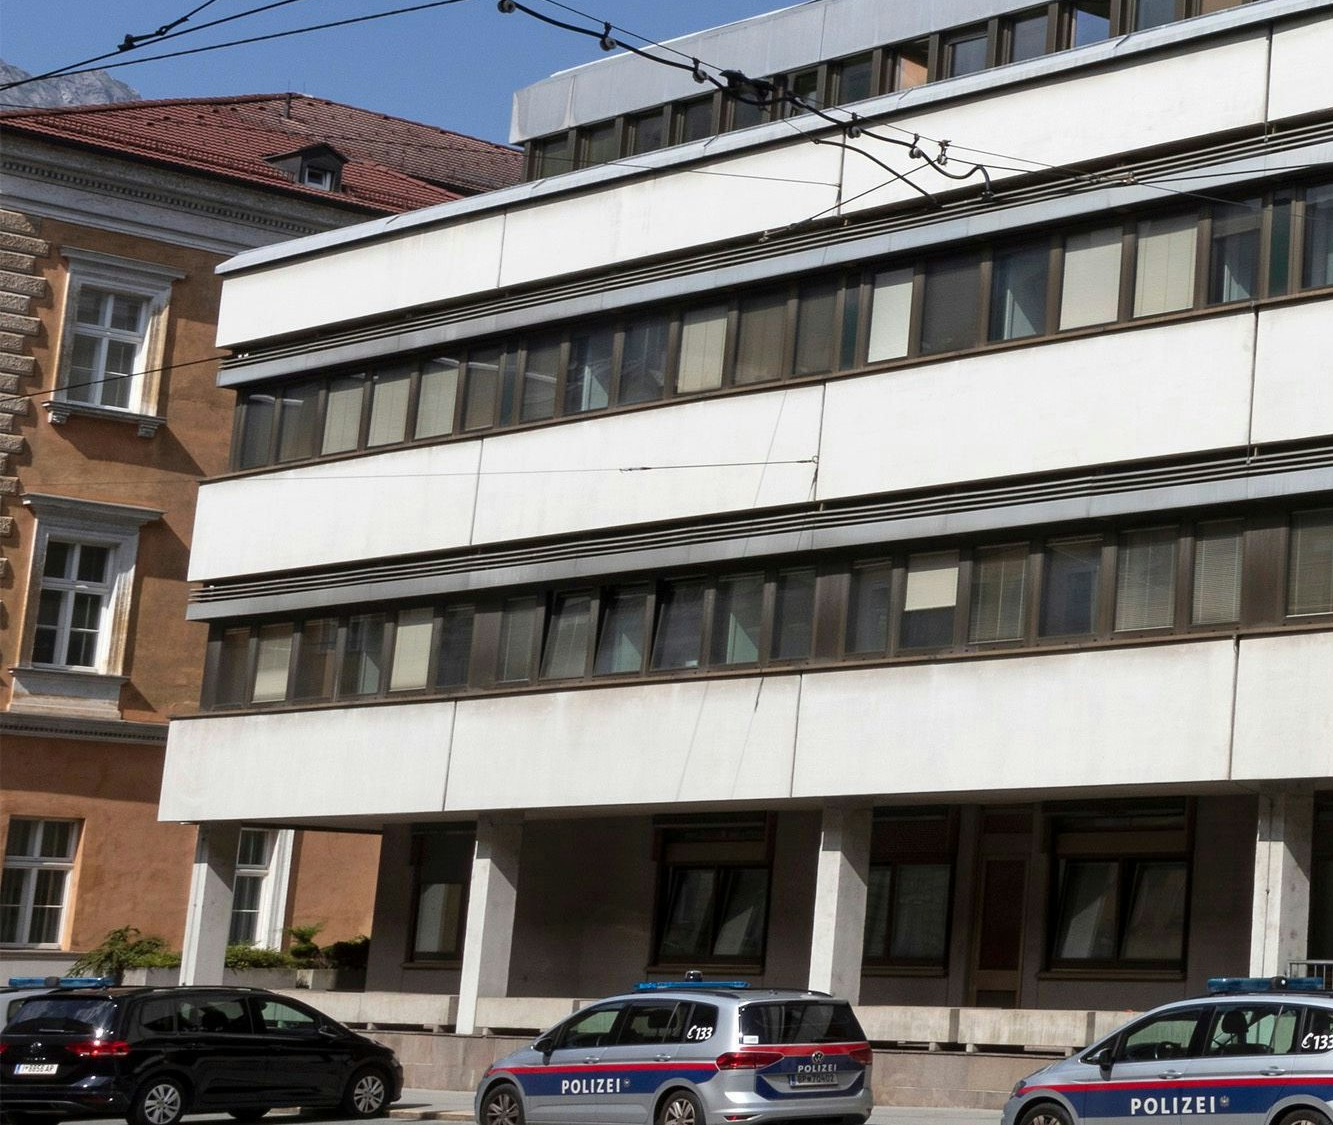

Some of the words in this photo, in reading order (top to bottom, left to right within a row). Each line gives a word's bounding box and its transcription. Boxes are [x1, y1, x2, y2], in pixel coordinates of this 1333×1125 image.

[695, 1026, 713, 1040] 133
[797, 1064, 837, 1073] POLIZEI
[561, 1078, 621, 1094] POLIZEI
[1130, 1096, 1216, 1115] POLIZEI
